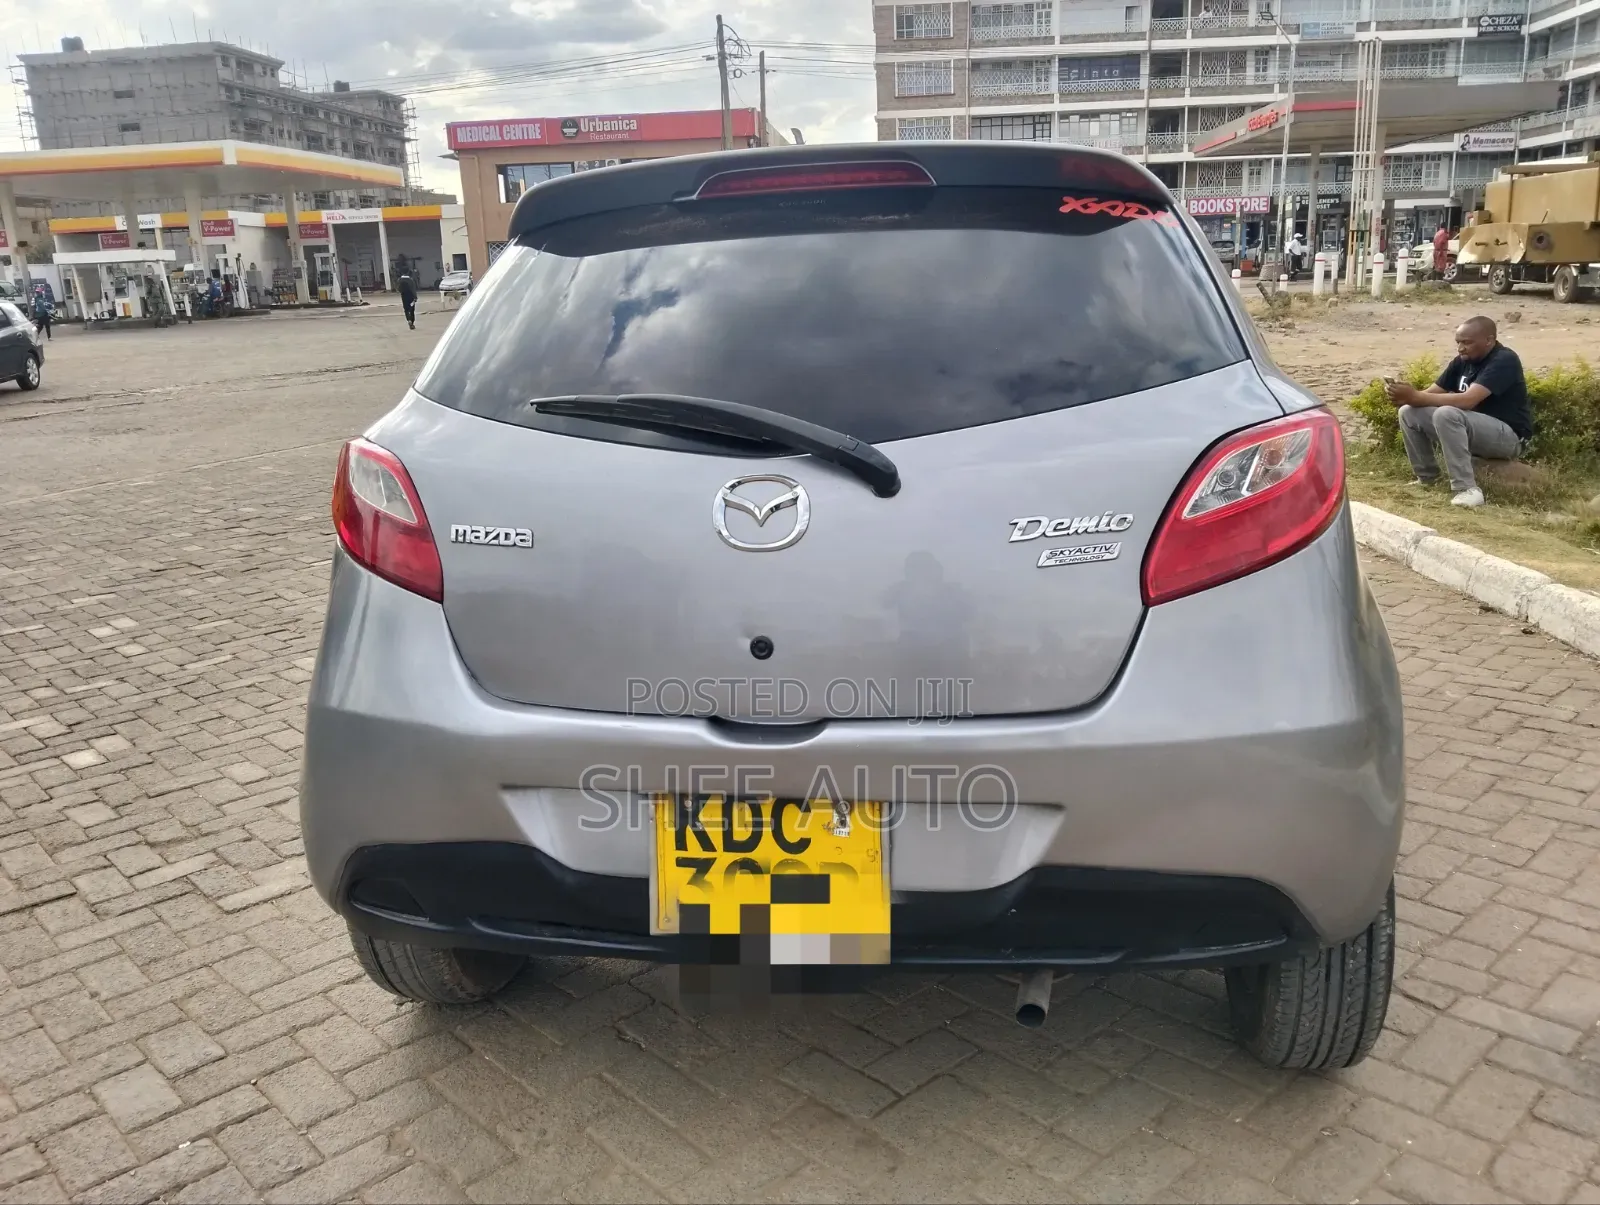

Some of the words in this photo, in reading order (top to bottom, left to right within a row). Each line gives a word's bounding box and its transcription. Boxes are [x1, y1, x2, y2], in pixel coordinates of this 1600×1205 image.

[456, 124, 502, 143] MEDICAL
[503, 123, 541, 141] CENTRE
[580, 116, 638, 133] Urbanica
[590, 132, 630, 141] Restaurant
[1188, 196, 1269, 214] BOOKSTORE
[1008, 510, 1134, 543] Demio
[1049, 544, 1114, 558] SKYACTIV
[1053, 554, 1106, 565] TECHNOLOGY
[674, 795, 813, 855] KDC
